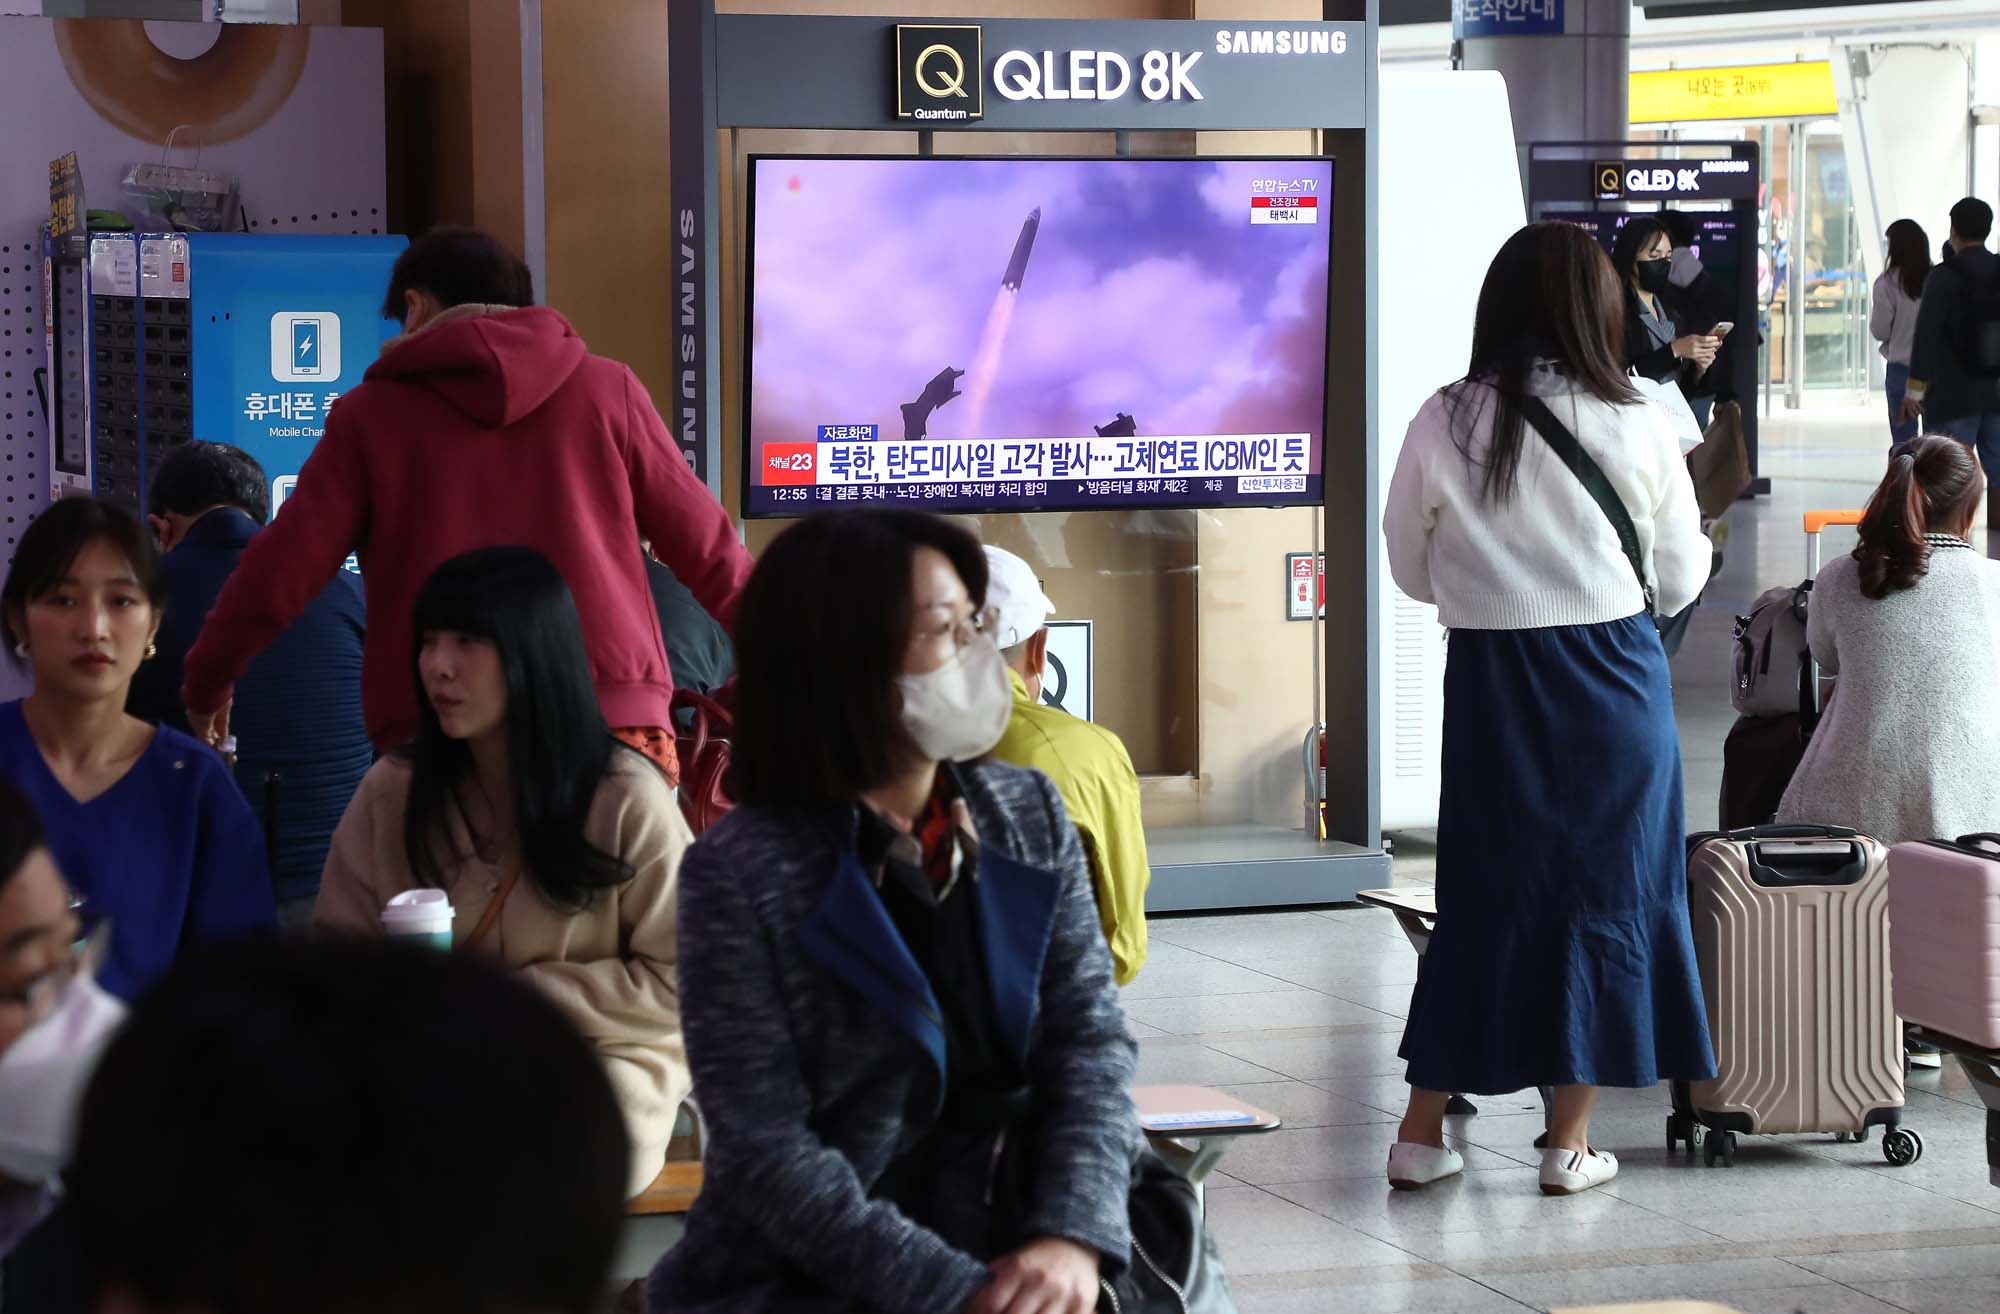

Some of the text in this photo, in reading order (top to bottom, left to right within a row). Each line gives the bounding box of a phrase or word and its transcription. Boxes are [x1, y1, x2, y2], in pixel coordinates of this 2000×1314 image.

[1215, 30, 1348, 55] SAMSUNG
[992, 49, 1204, 101] QLED 8K
[914, 108, 967, 121] Quantum
[1626, 169, 1700, 191] QLED 8K
[1269, 197, 1299, 207] 건조경보
[1269, 209, 1299, 221] 태백시
[244, 392, 317, 421] 휴대폰
[269, 427, 301, 437] Mobile
[823, 425, 872, 441] 자료화면
[829, 445, 880, 482] 북한,
[886, 443, 995, 480] 탄도미사일
[1000, 442, 1046, 478] 고각
[1204, 438, 1278, 473] ICBM인
[1283, 438, 1305, 472] 듯
[835, 486, 859, 500] 결론
[961, 483, 995, 498] 복지법
[998, 482, 1022, 497] 처리
[1024, 481, 1048, 497] 합의
[1086, 480, 1134, 495] '방음터널
[1136, 480, 1161, 493] 화재'
[1204, 479, 1224, 492] 제공
[1241, 477, 1304, 491] 신한투자증권
[772, 488, 808, 501] 12:55
